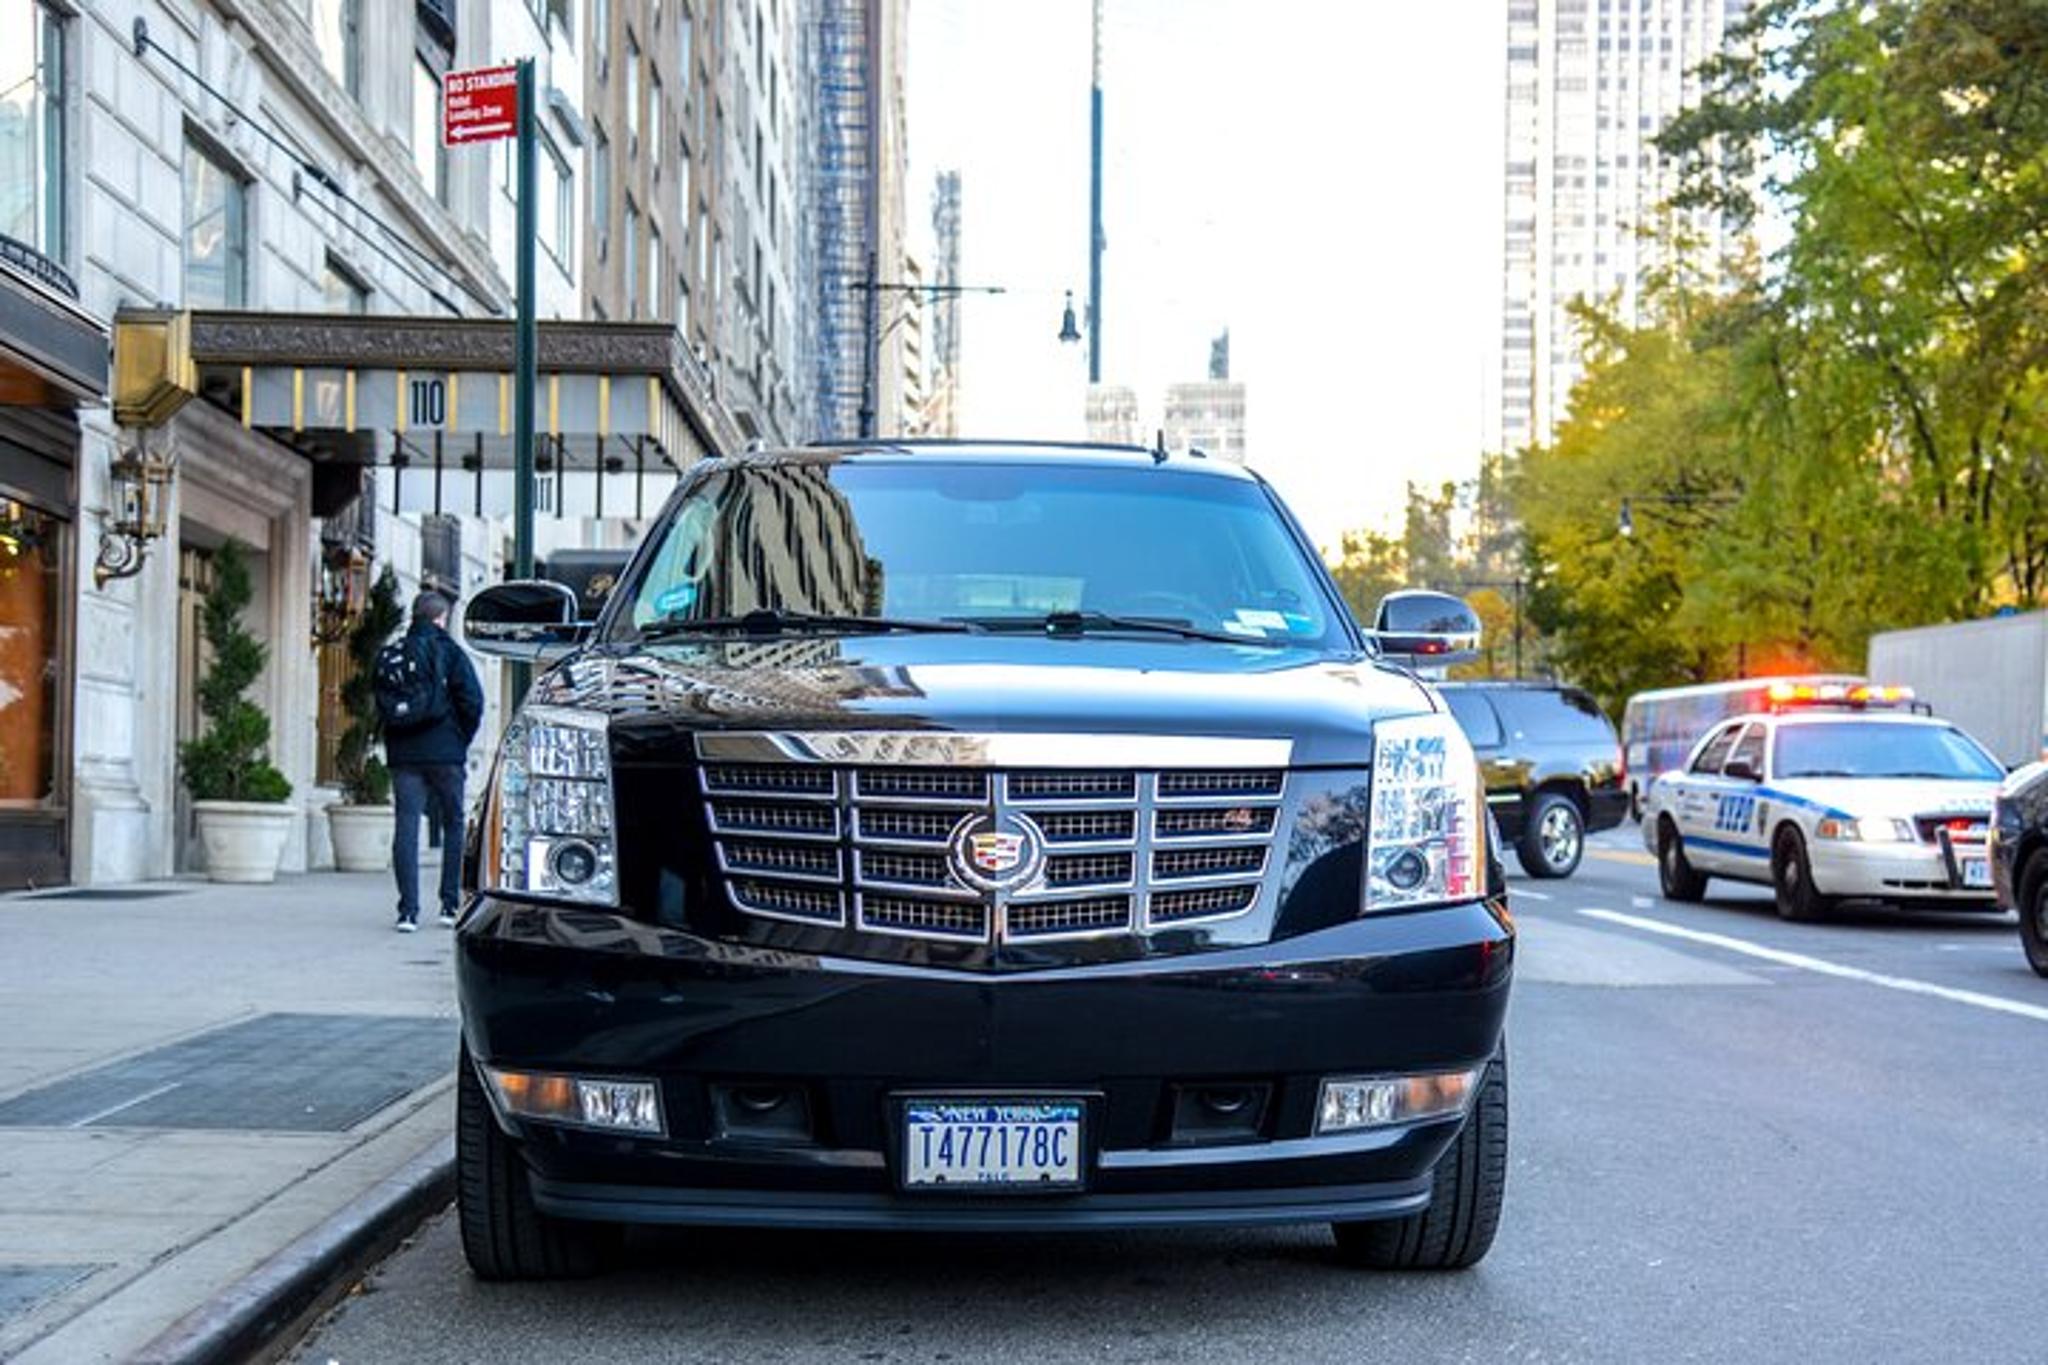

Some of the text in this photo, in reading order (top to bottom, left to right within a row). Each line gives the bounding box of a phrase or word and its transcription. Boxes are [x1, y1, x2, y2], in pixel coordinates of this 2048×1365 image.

[449, 79, 464, 92] NO
[412, 380, 444, 424] 110
[1715, 796, 1755, 832] NYPD
[919, 1126, 1068, 1168] T477178C
